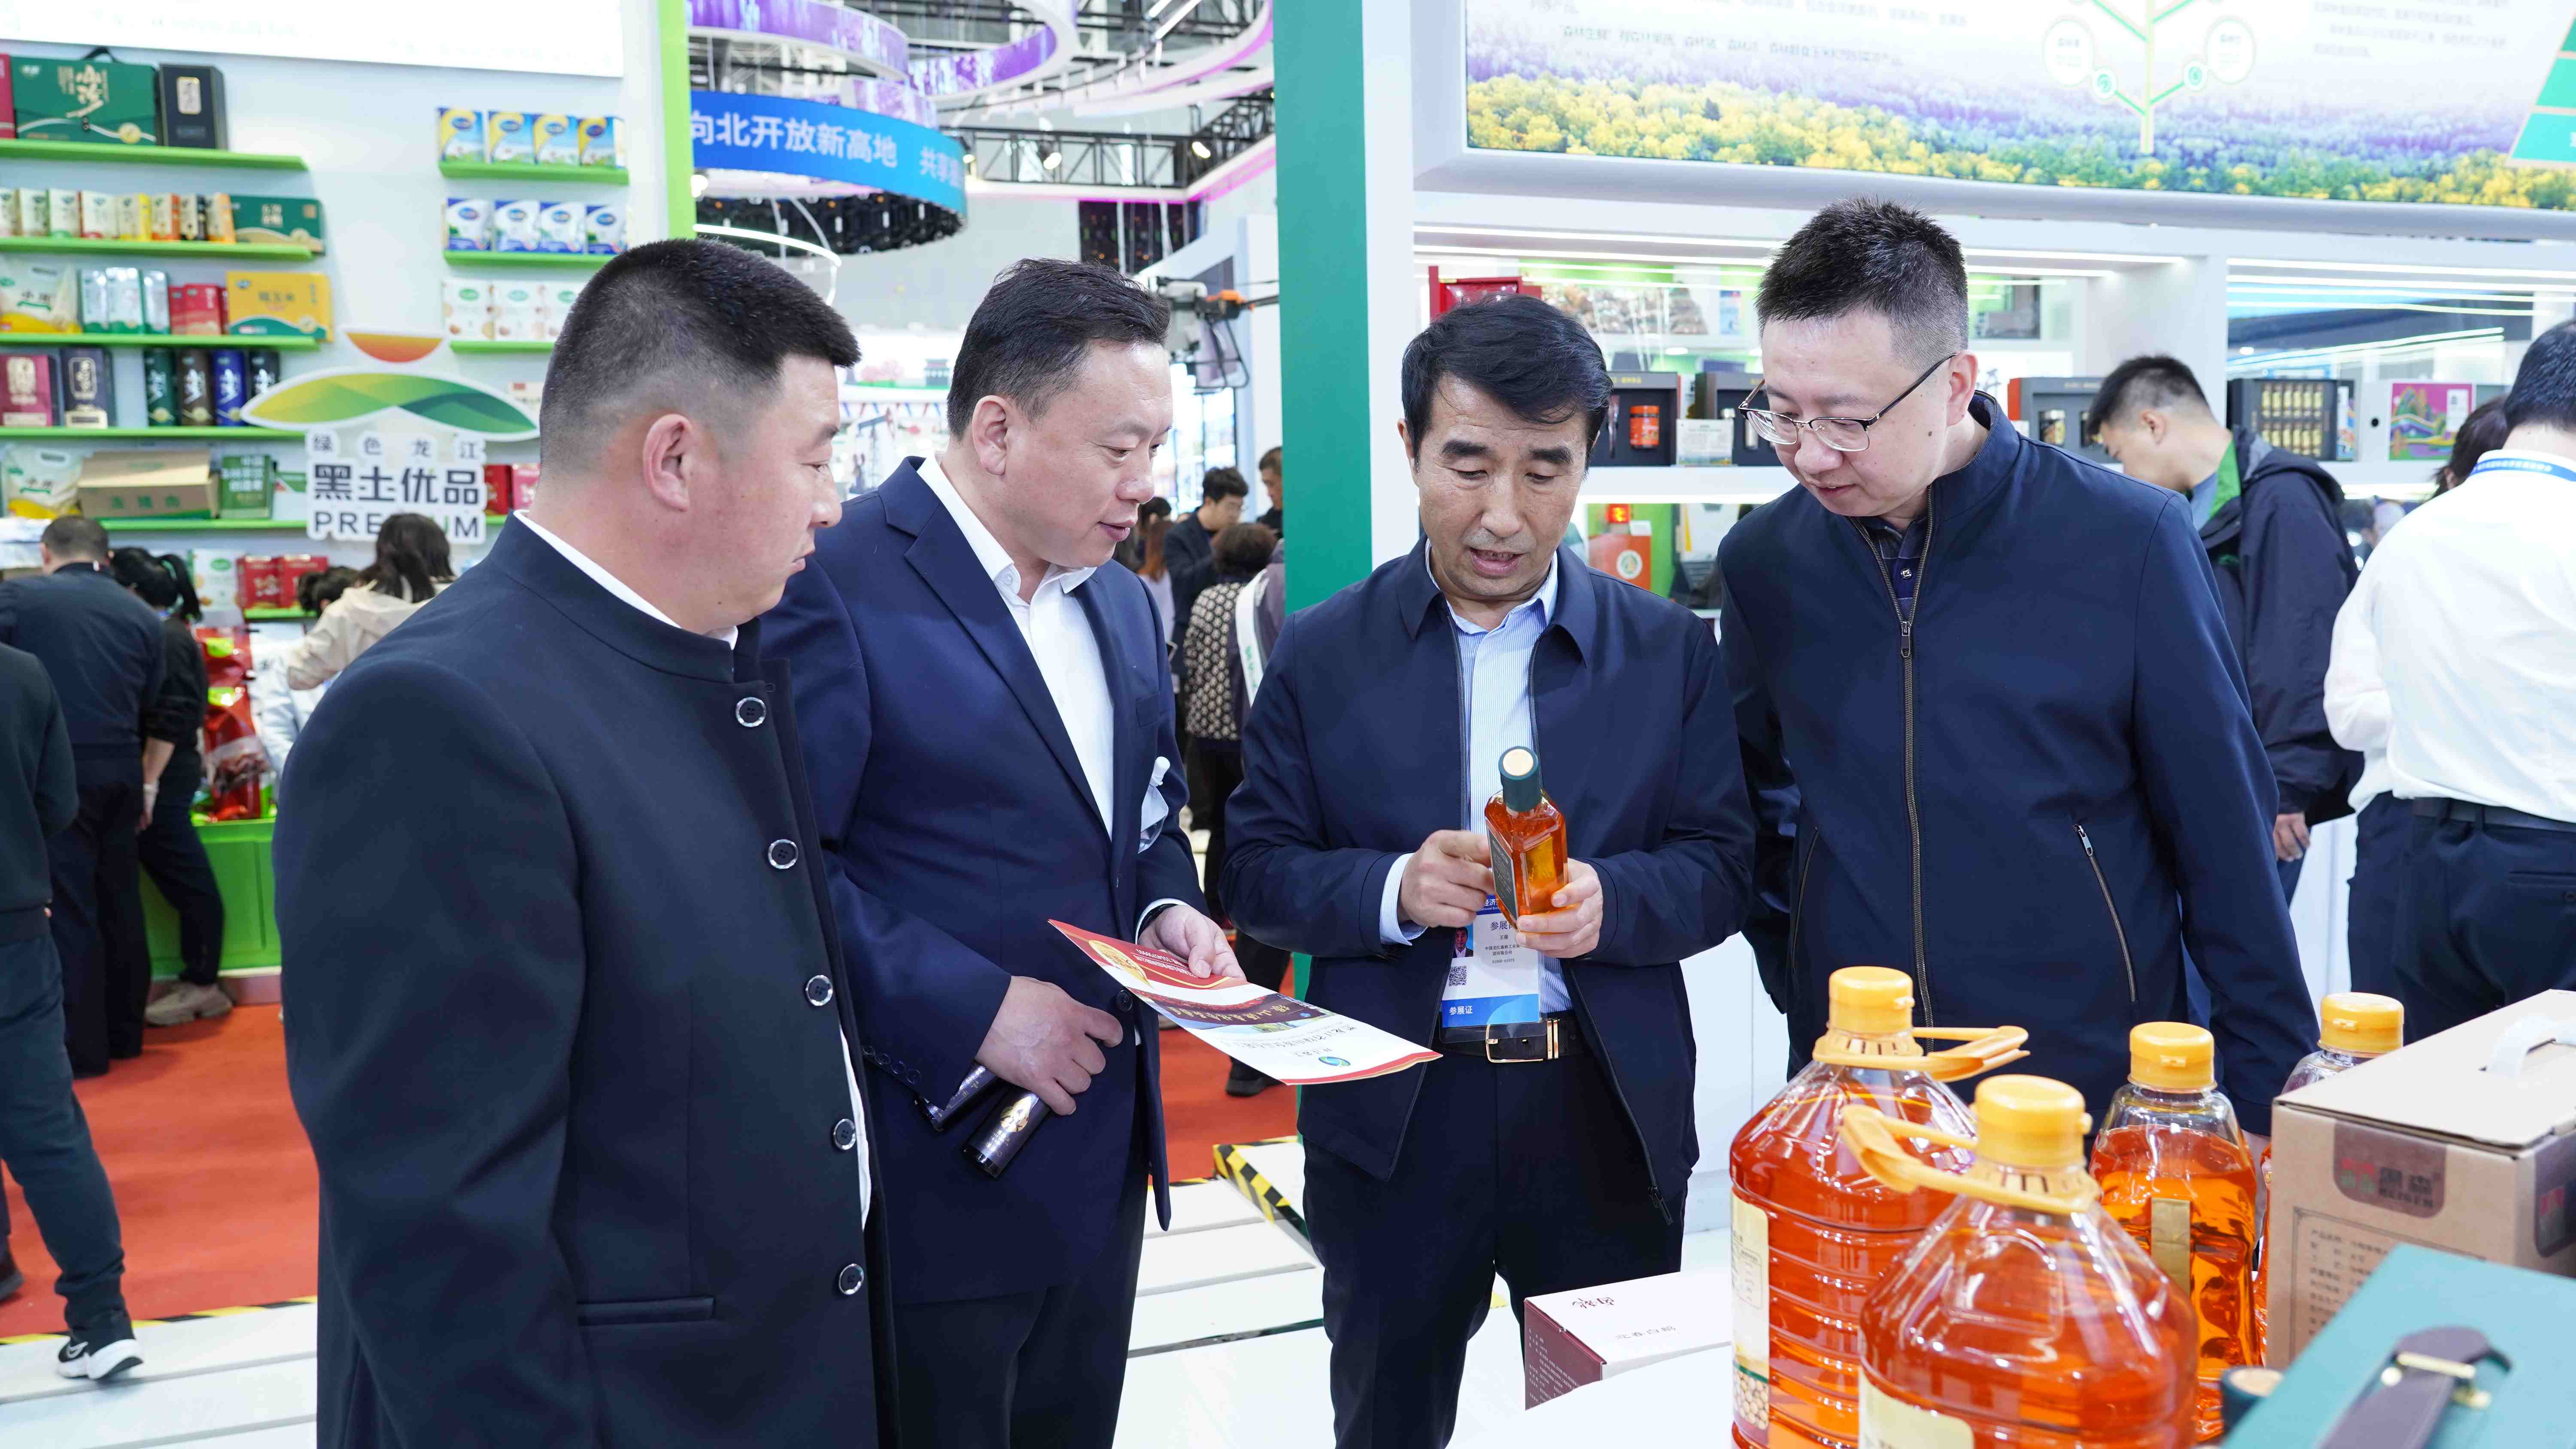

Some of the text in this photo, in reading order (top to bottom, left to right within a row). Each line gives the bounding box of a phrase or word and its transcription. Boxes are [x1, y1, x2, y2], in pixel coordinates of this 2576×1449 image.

[691, 111, 898, 168] 向北开放新高地
[313, 434, 478, 460] 绿色龙江
[314, 464, 479, 506] 黑土优品
[1449, 1005, 1473, 1016] 参展证
